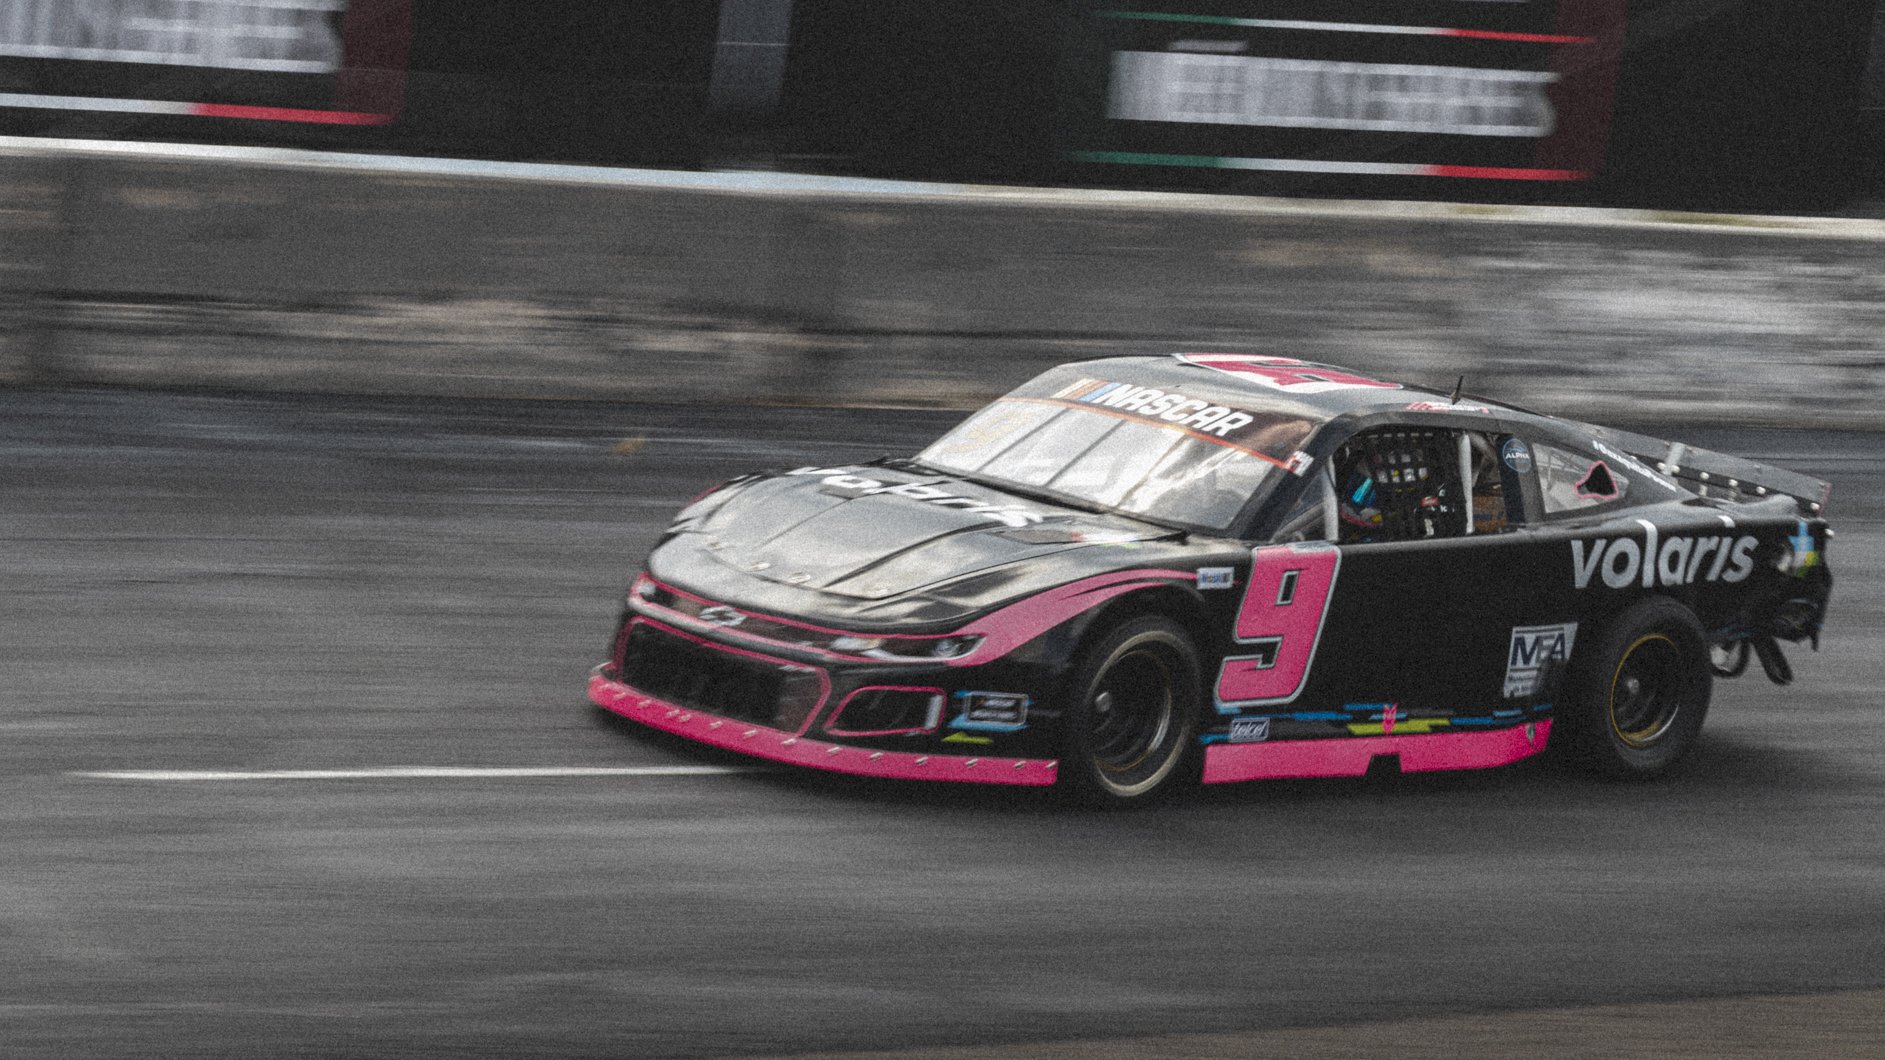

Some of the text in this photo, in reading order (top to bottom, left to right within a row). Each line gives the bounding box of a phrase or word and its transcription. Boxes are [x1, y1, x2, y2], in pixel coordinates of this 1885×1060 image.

[1091, 383, 1254, 437] NASCAR
[1570, 515, 1760, 589] volaris
[1213, 546, 1342, 707] 9
[1511, 633, 1566, 667] MFA
